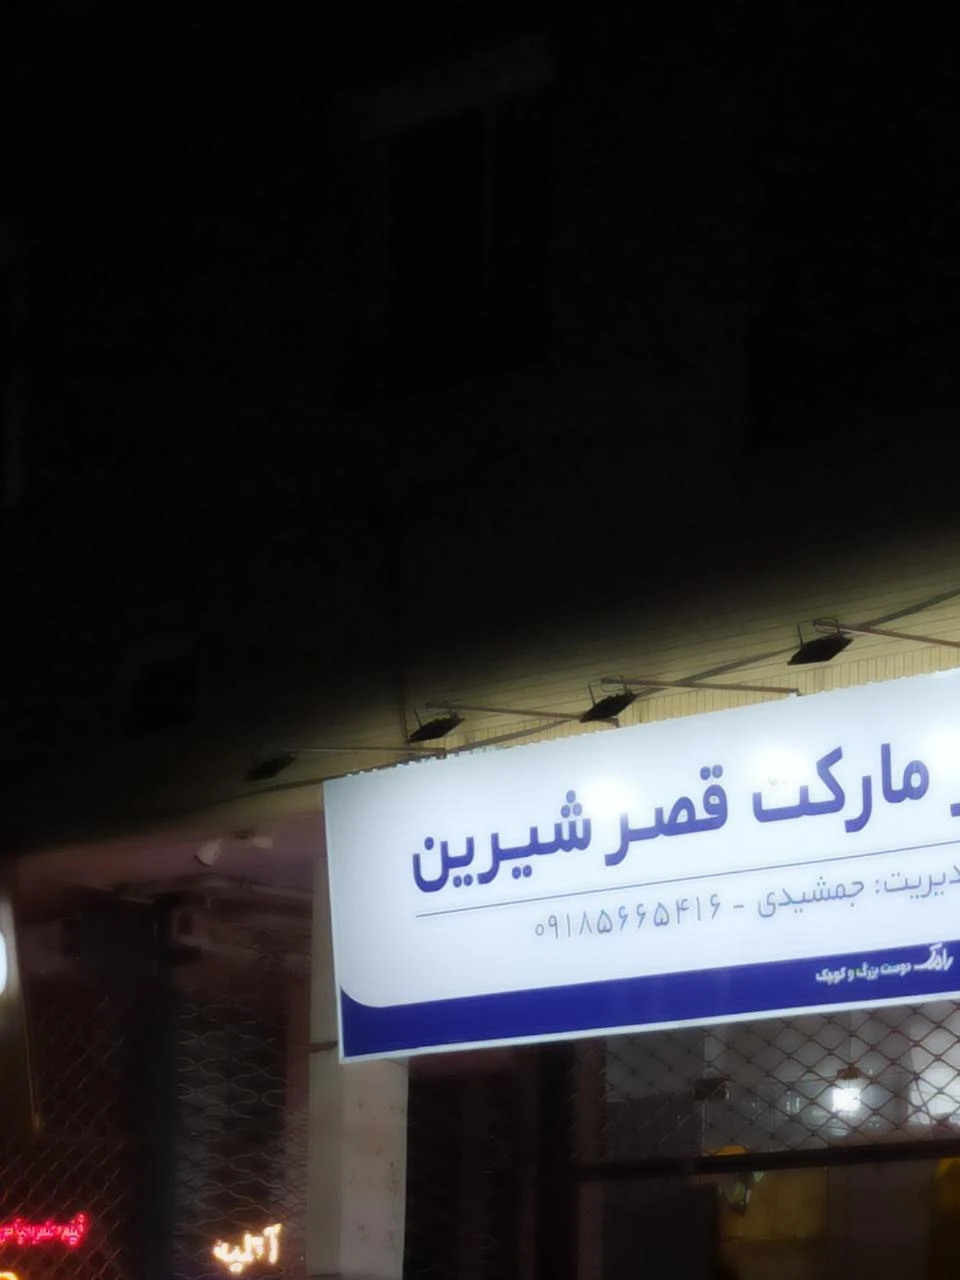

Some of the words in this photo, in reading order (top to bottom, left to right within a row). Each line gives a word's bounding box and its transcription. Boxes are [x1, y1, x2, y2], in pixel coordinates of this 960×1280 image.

[604, 764, 730, 867] قصر
[752, 743, 930, 834] مارکت
[411, 789, 593, 894] شیرین
[757, 876, 866, 920] جمشیدی
[815, 966, 847, 987] کوچک
[879, 961, 912, 977] دوست
